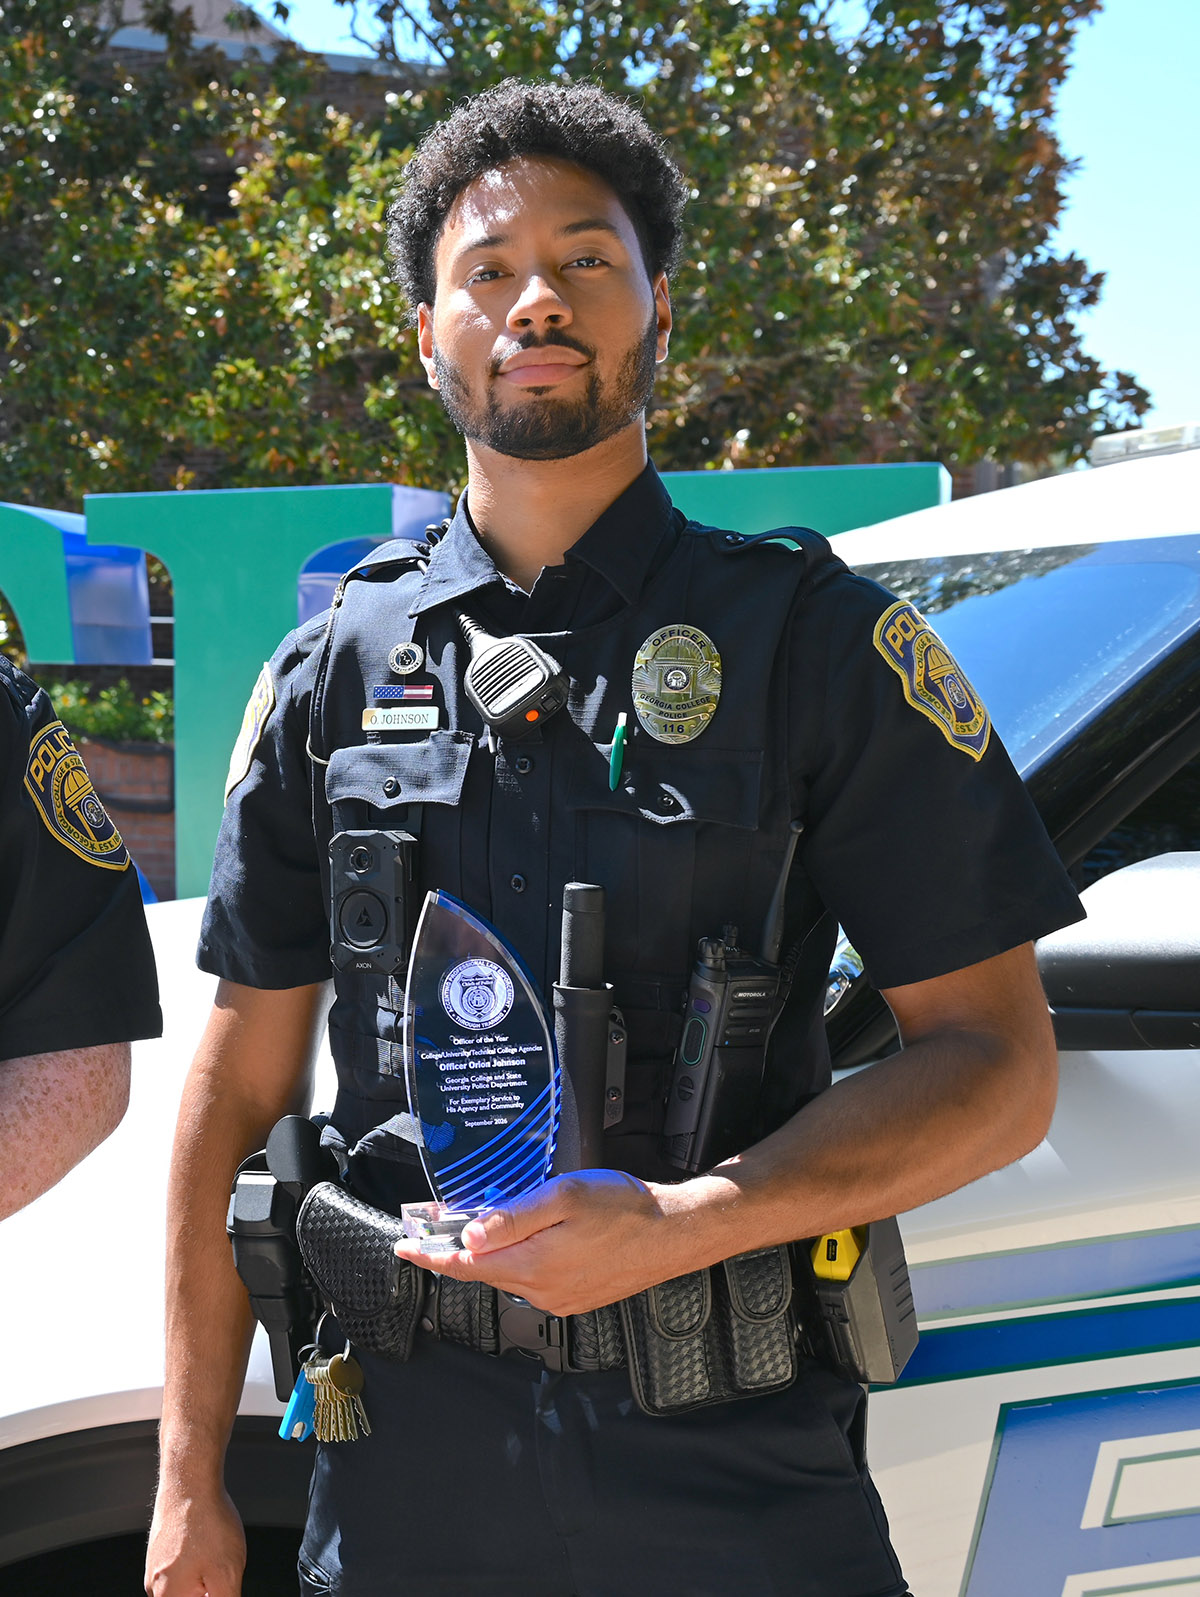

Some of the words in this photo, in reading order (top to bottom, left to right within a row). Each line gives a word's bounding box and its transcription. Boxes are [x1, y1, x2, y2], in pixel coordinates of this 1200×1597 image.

[652, 629, 707, 649] OFFICER
[640, 693, 673, 710] GEORGIA
[675, 695, 711, 710] COLLEGE
[381, 713, 429, 725] JOHNSON
[659, 711, 688, 719] POLICE
[662, 724, 685, 734] 116
[29, 730, 76, 793] POLIC
[53, 765, 66, 809] COLLEGE
[57, 811, 93, 848] GEORGIA
[453, 1038, 474, 1046] Officer
[497, 1046, 518, 1055] College
[518, 1045, 543, 1053] Agencies
[439, 1062, 468, 1071] Officer
[468, 1060, 491, 1069] Orion
[492, 1058, 526, 1068] Johnson
[445, 1076, 469, 1085] Georgia
[470, 1074, 493, 1084] College
[506, 1072, 522, 1080] State
[440, 1083, 471, 1092] University
[472, 1082, 490, 1090] Police
[490, 1080, 528, 1089] Department
[460, 1096, 491, 1105] Exemplary
[491, 1095, 513, 1103] Service
[457, 1105, 479, 1114] Agency
[490, 1102, 525, 1111] Community
[464, 1120, 493, 1128] September
[494, 1117, 508, 1125] 2026
